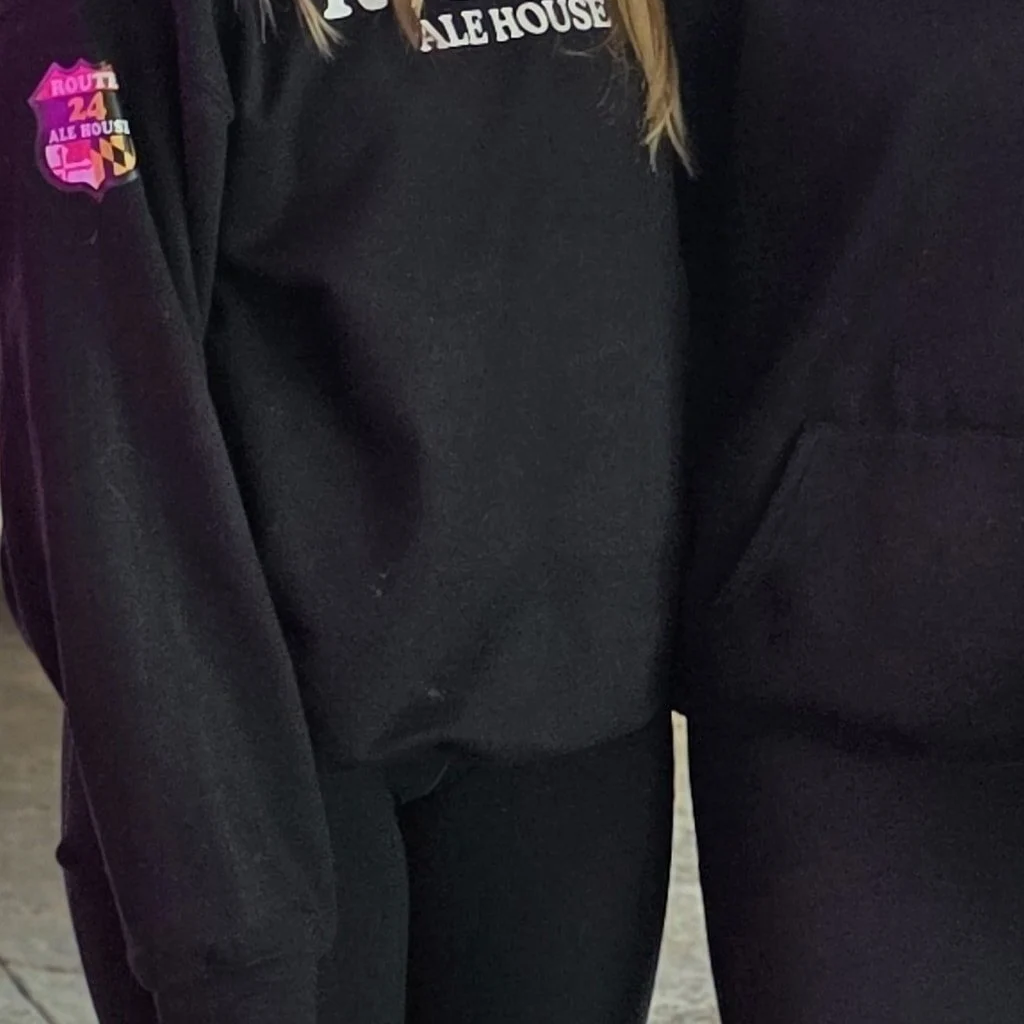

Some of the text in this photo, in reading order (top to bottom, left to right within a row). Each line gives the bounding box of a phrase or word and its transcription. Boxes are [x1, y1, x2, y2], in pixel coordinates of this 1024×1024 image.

[420, 9, 489, 52] ALE
[67, 91, 107, 122] 24
[49, 125, 77, 144] ALE
